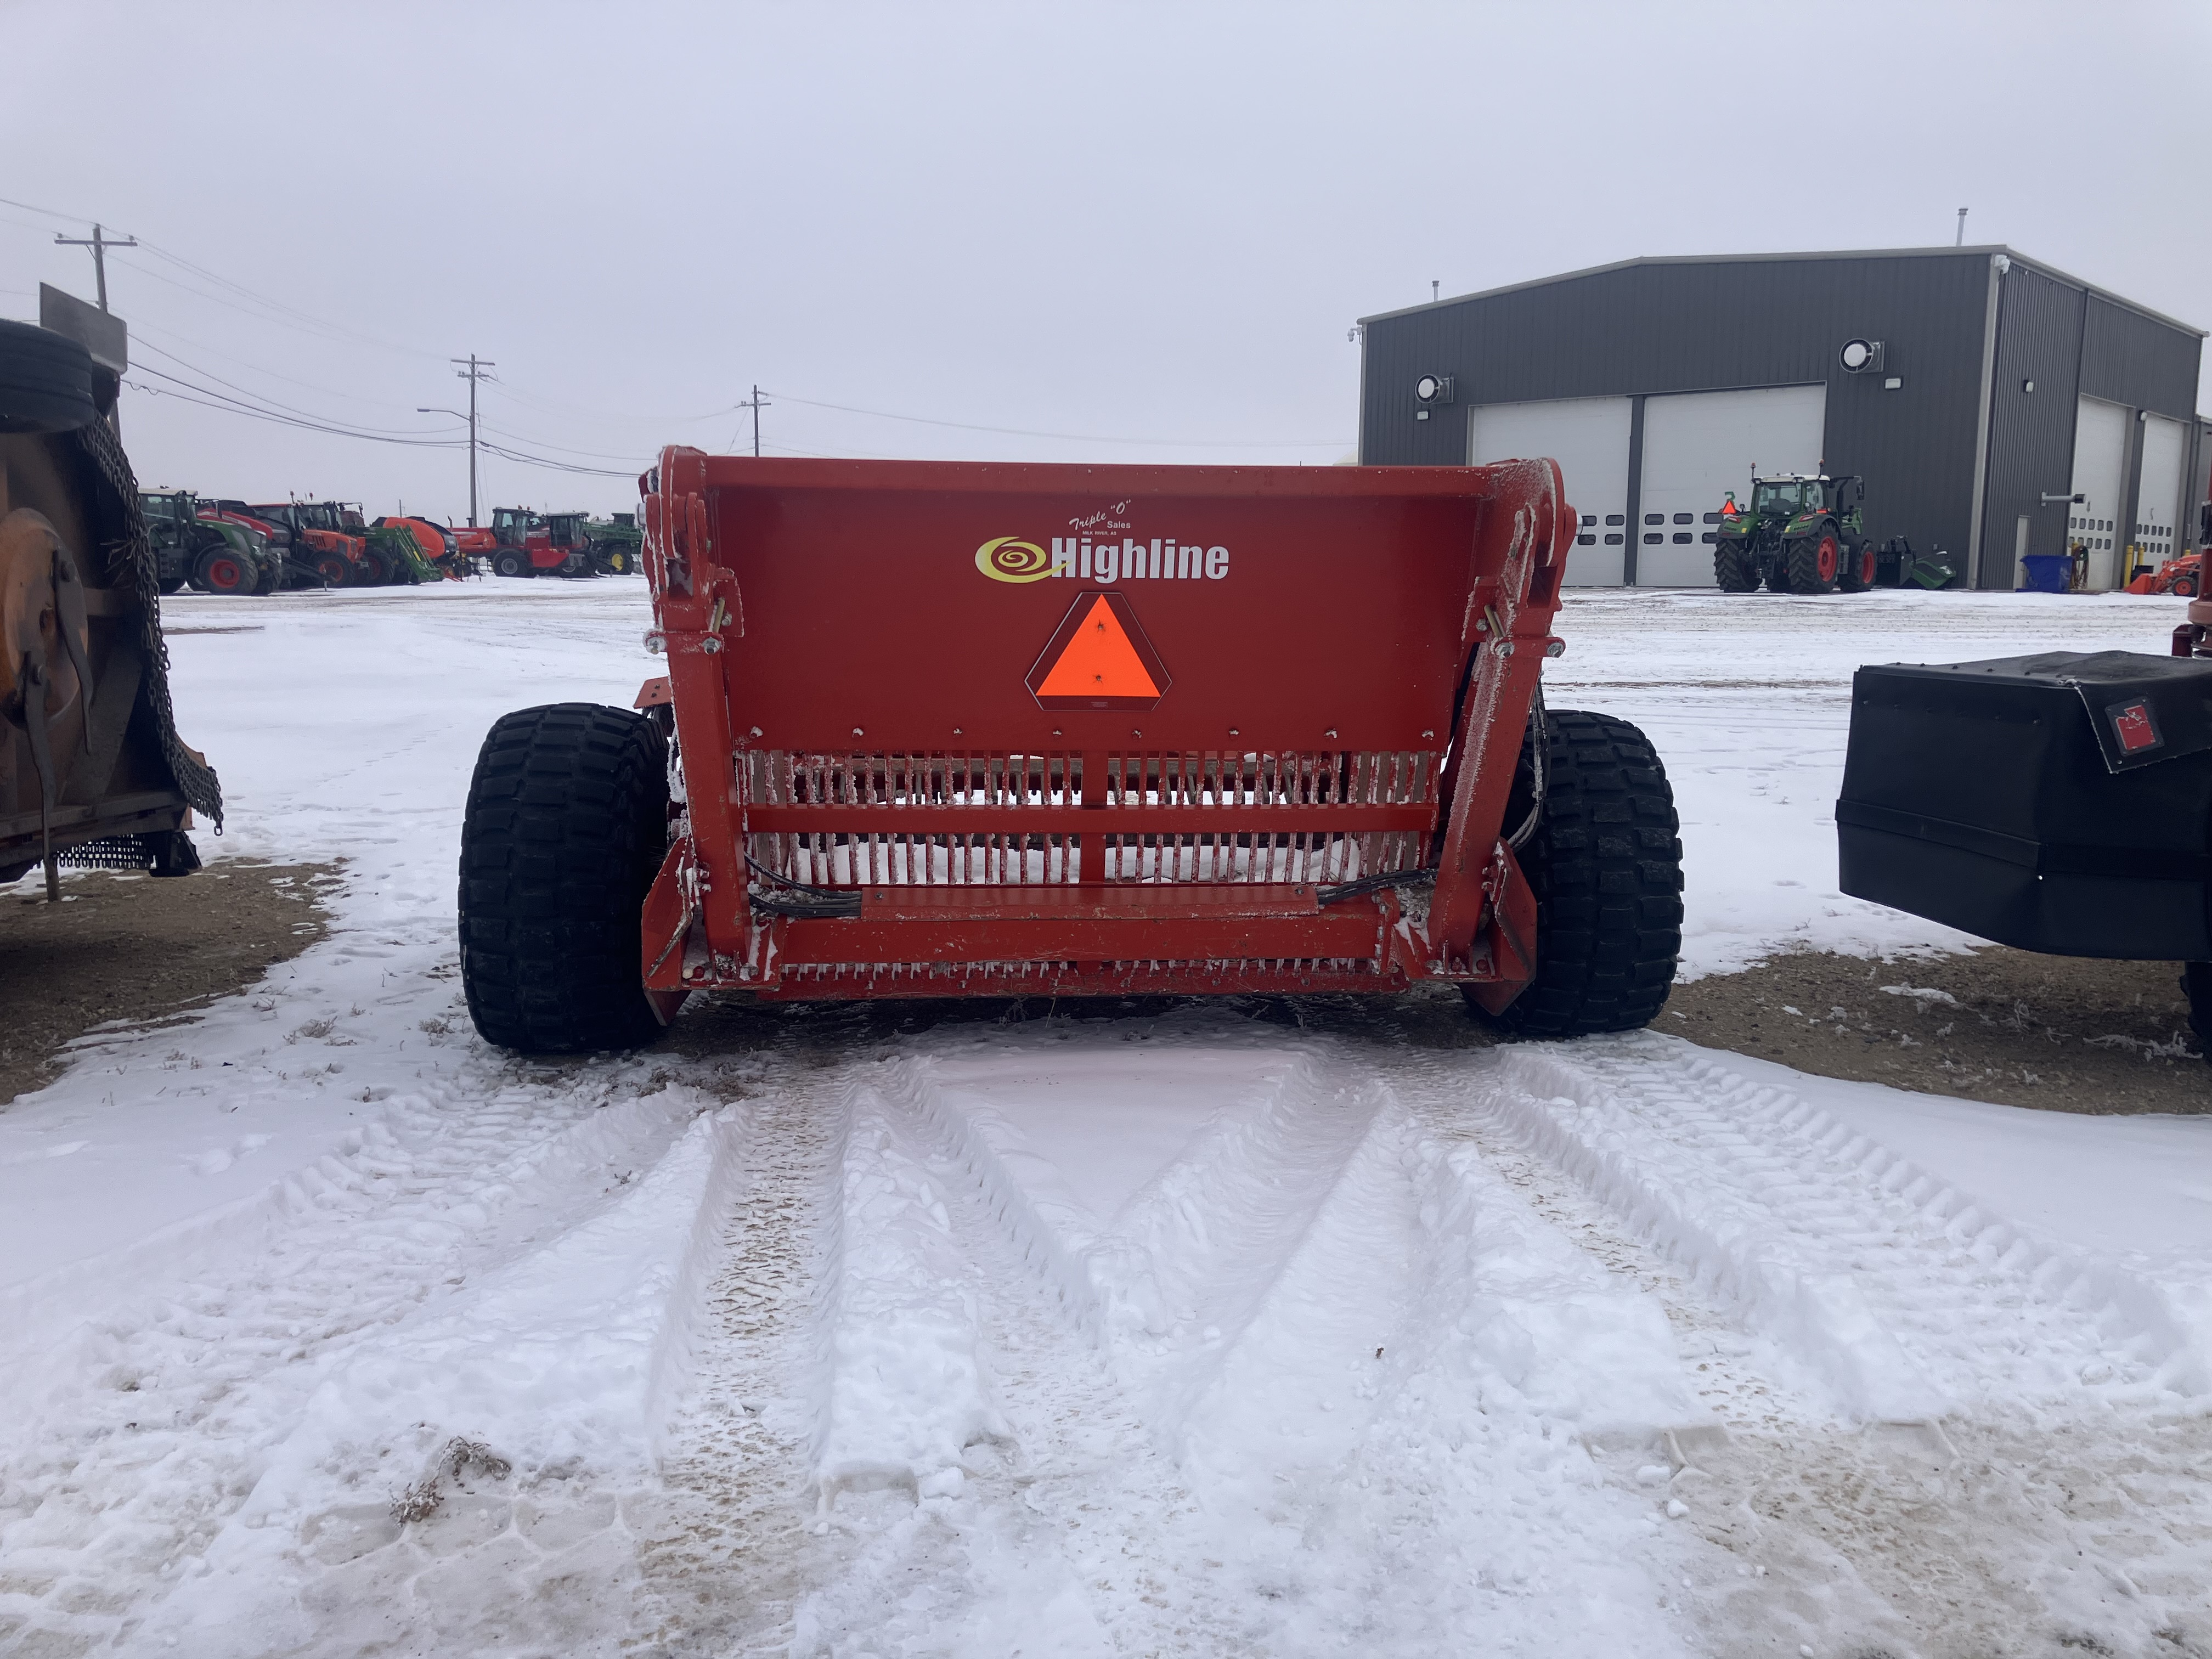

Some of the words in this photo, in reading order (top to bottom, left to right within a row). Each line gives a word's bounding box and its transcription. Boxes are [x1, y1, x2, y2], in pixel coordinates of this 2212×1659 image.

[1069, 511, 1107, 531] Triple
[1107, 521, 1131, 529] Sales
[1051, 537, 1229, 584] Highline
